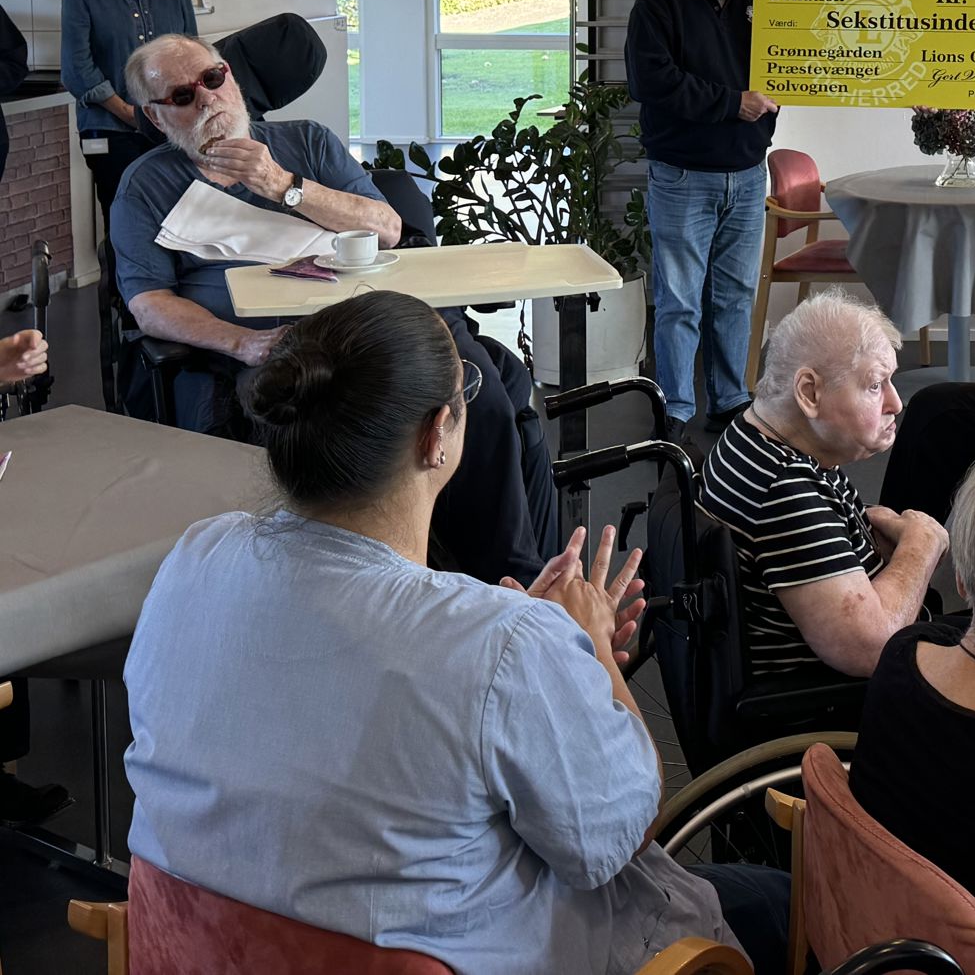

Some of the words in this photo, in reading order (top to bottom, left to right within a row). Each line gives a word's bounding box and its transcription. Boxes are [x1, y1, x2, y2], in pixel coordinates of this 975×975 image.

[769, 19, 798, 28] Værdi:
[767, 44, 883, 60] Grønnegården
[921, 49, 965, 63] Lions
[766, 62, 880, 79] Præstevænget
[766, 79, 848, 95] Solvognen
